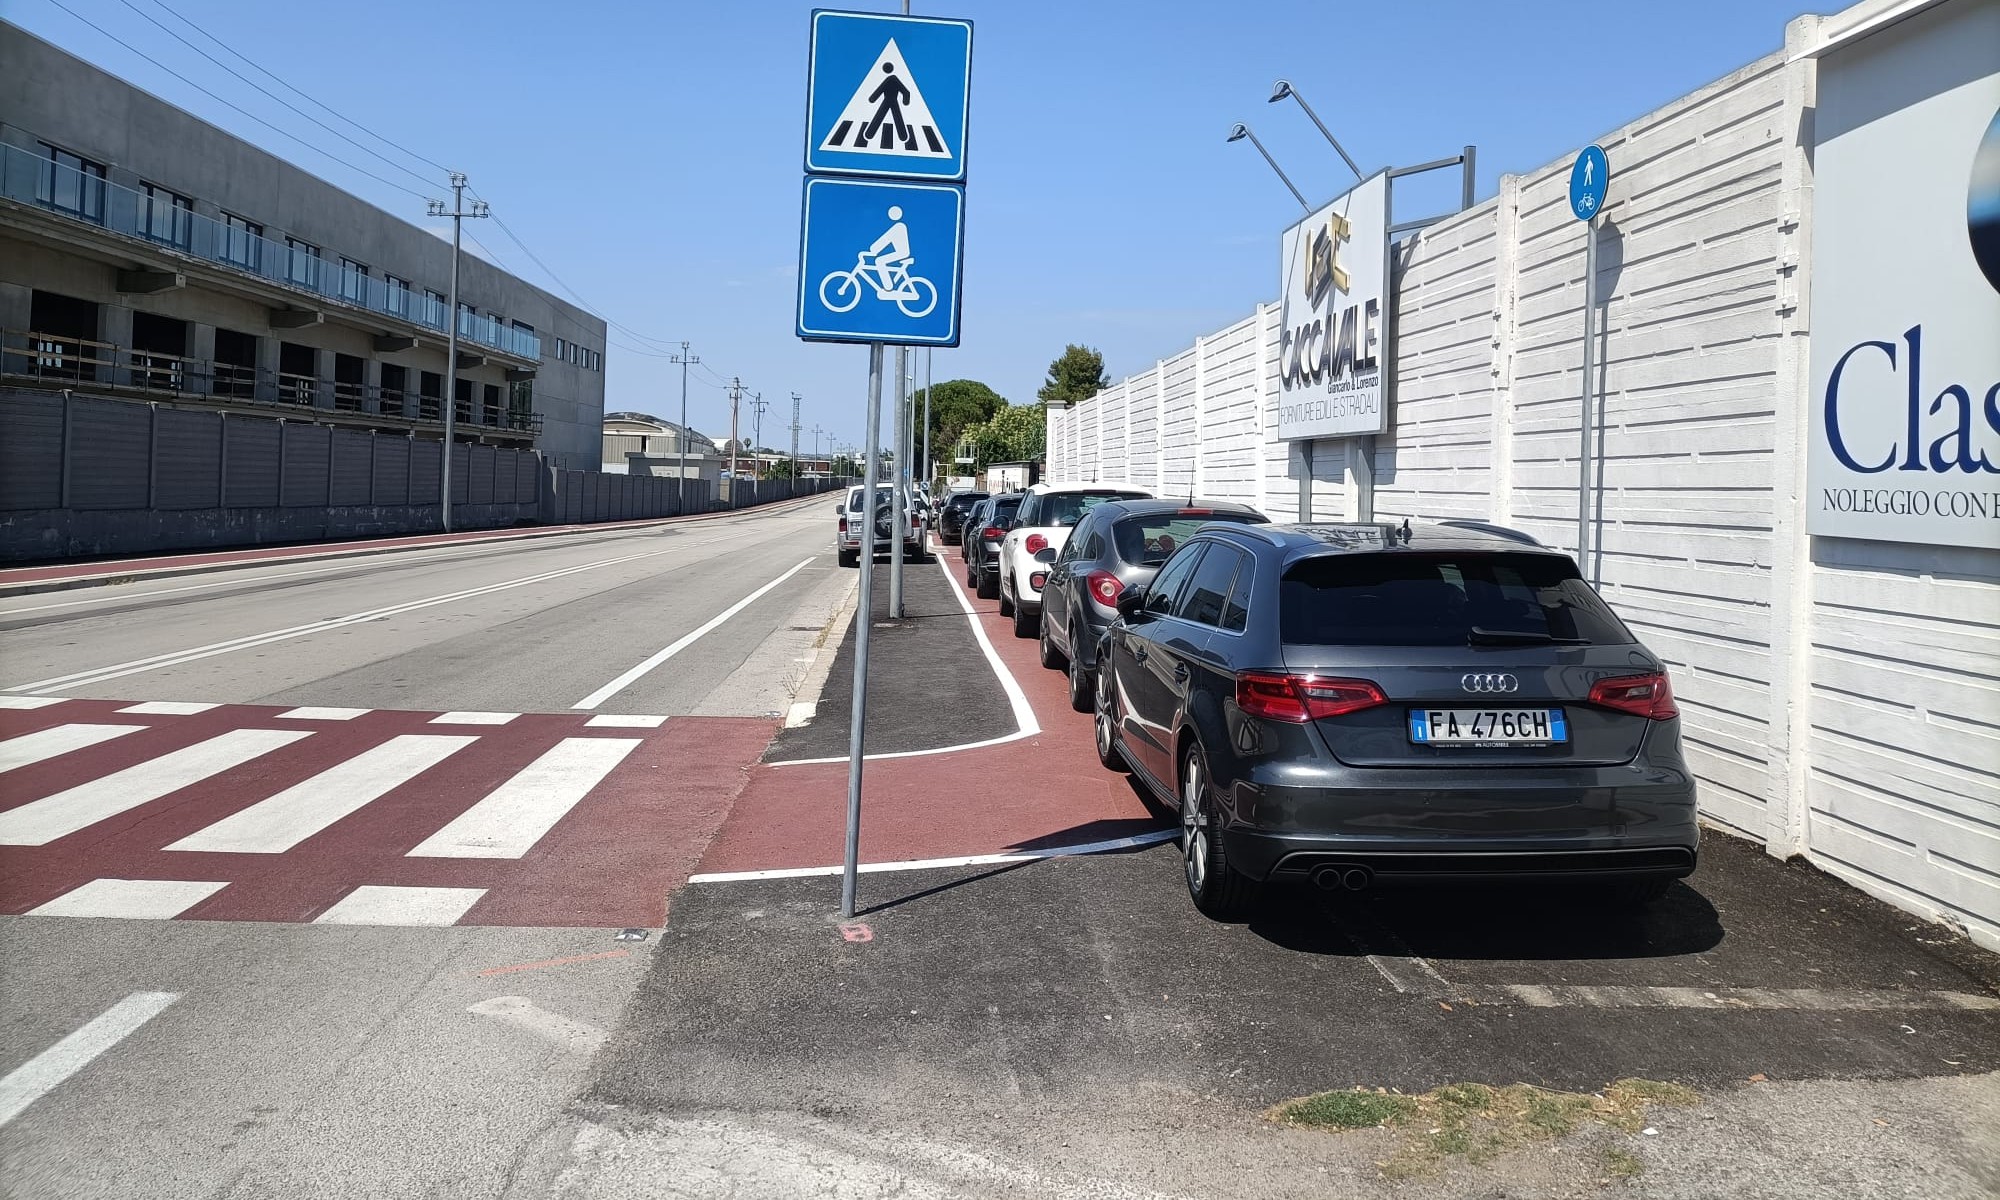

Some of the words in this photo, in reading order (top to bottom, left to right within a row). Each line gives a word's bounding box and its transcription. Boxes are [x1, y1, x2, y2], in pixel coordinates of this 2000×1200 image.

[1281, 298, 1379, 388] CACCAVALE
[1328, 379, 1350, 394] Giancarlo
[1356, 375, 1379, 390] Lorenzo
[1280, 400, 1314, 425] FORNITURE
[1339, 390, 1379, 417] STRADALI
[1823, 487, 1930, 517] NOLEGGIO
[1934, 490, 1987, 519] CON
[1429, 711, 1461, 738] FA
[1471, 711, 1548, 739] 476CH
